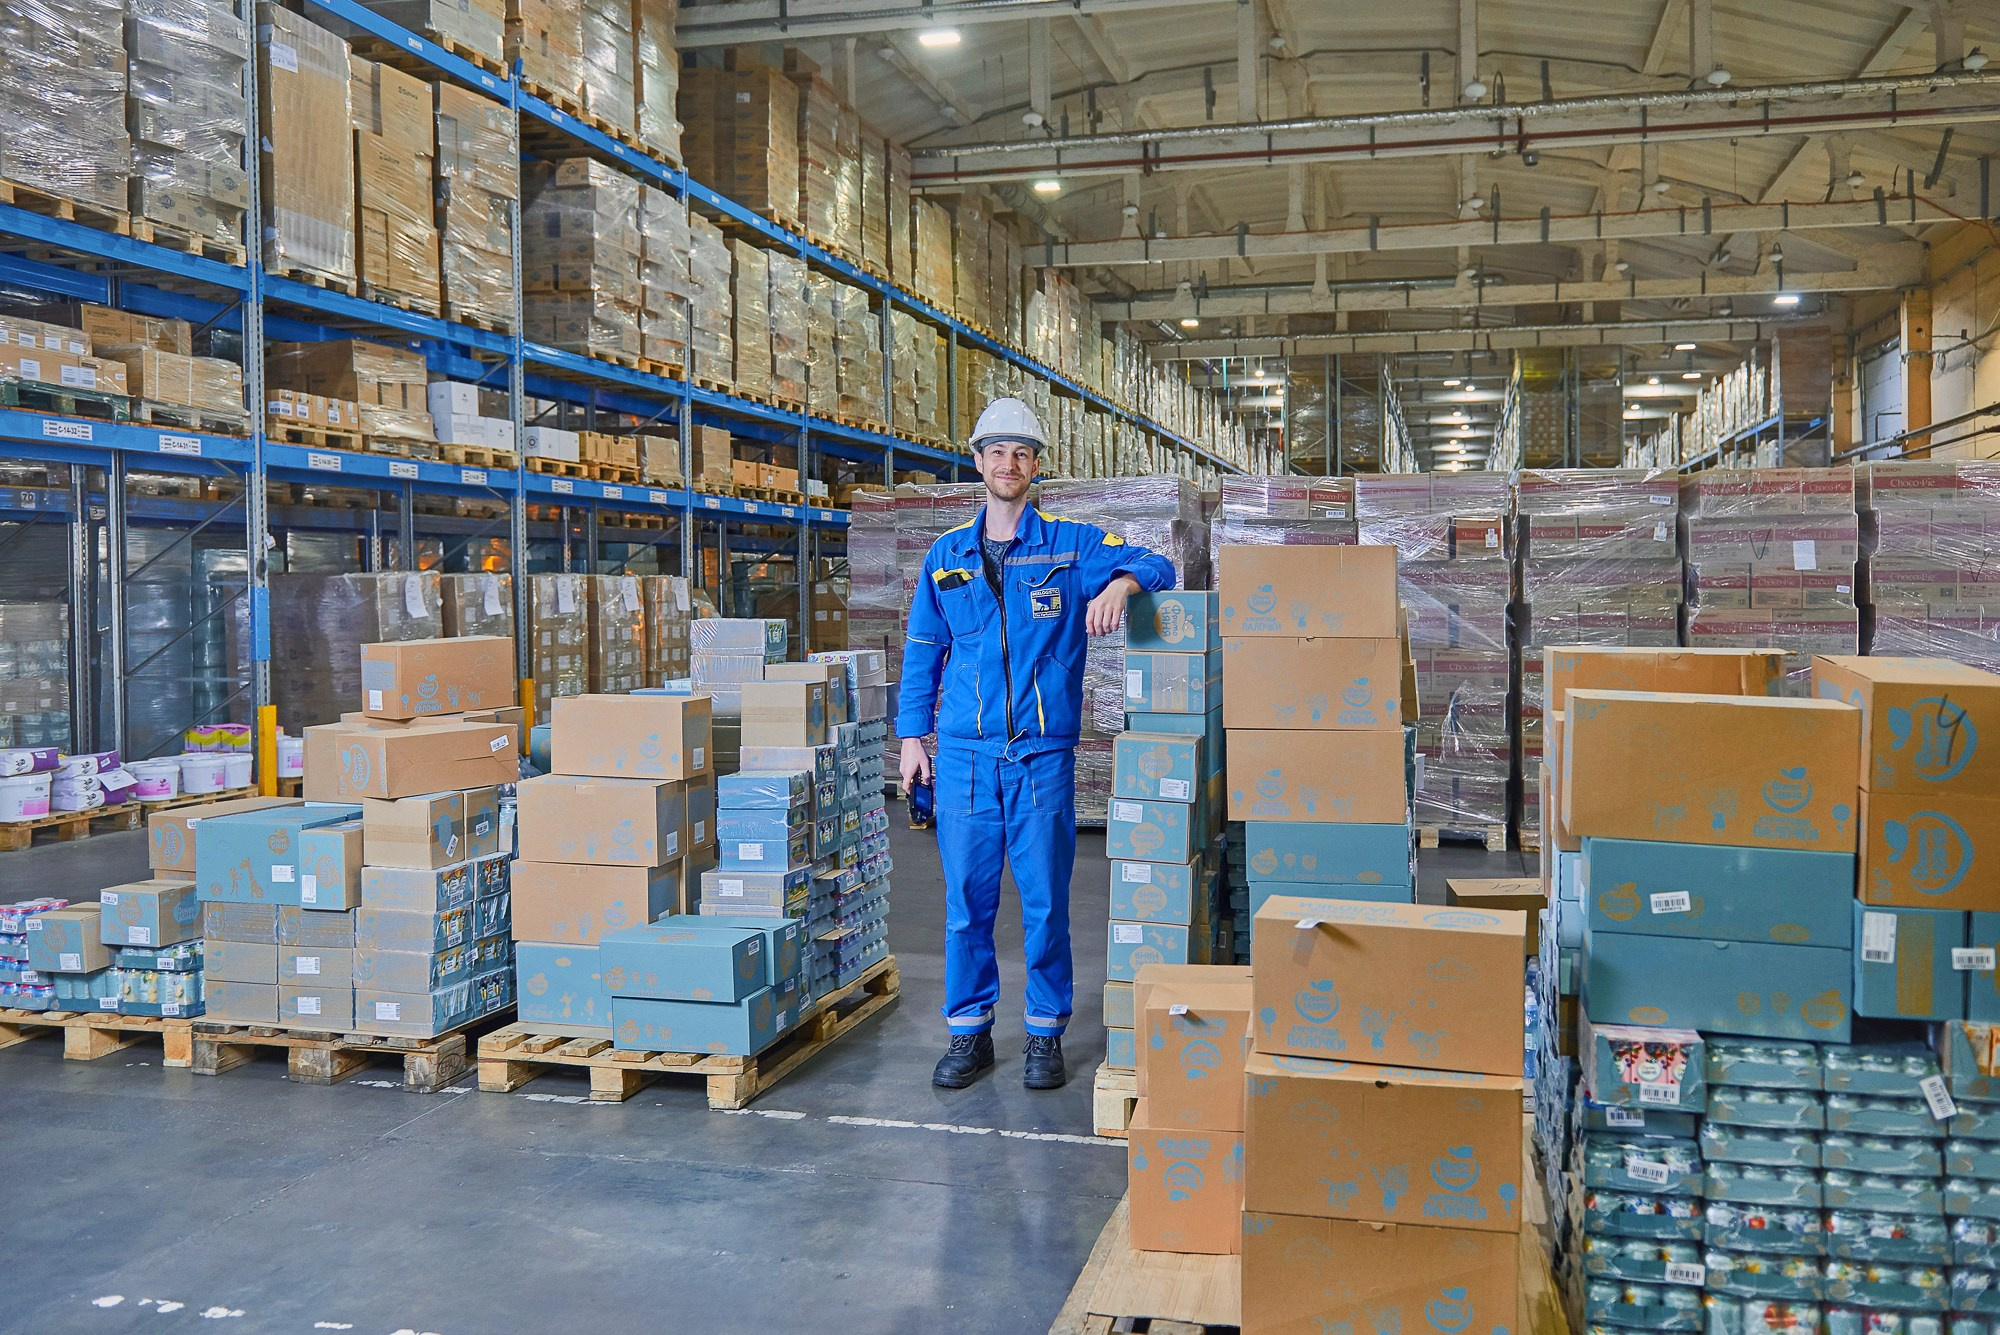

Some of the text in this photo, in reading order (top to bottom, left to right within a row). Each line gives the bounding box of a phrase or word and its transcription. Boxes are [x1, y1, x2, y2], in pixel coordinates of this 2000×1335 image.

[1171, 605, 1181, 636] Фруто
[1287, 1034, 1347, 1052] ПАЛОЧКИ
[1423, 1202, 1487, 1220] ПАЛОЧКИ
